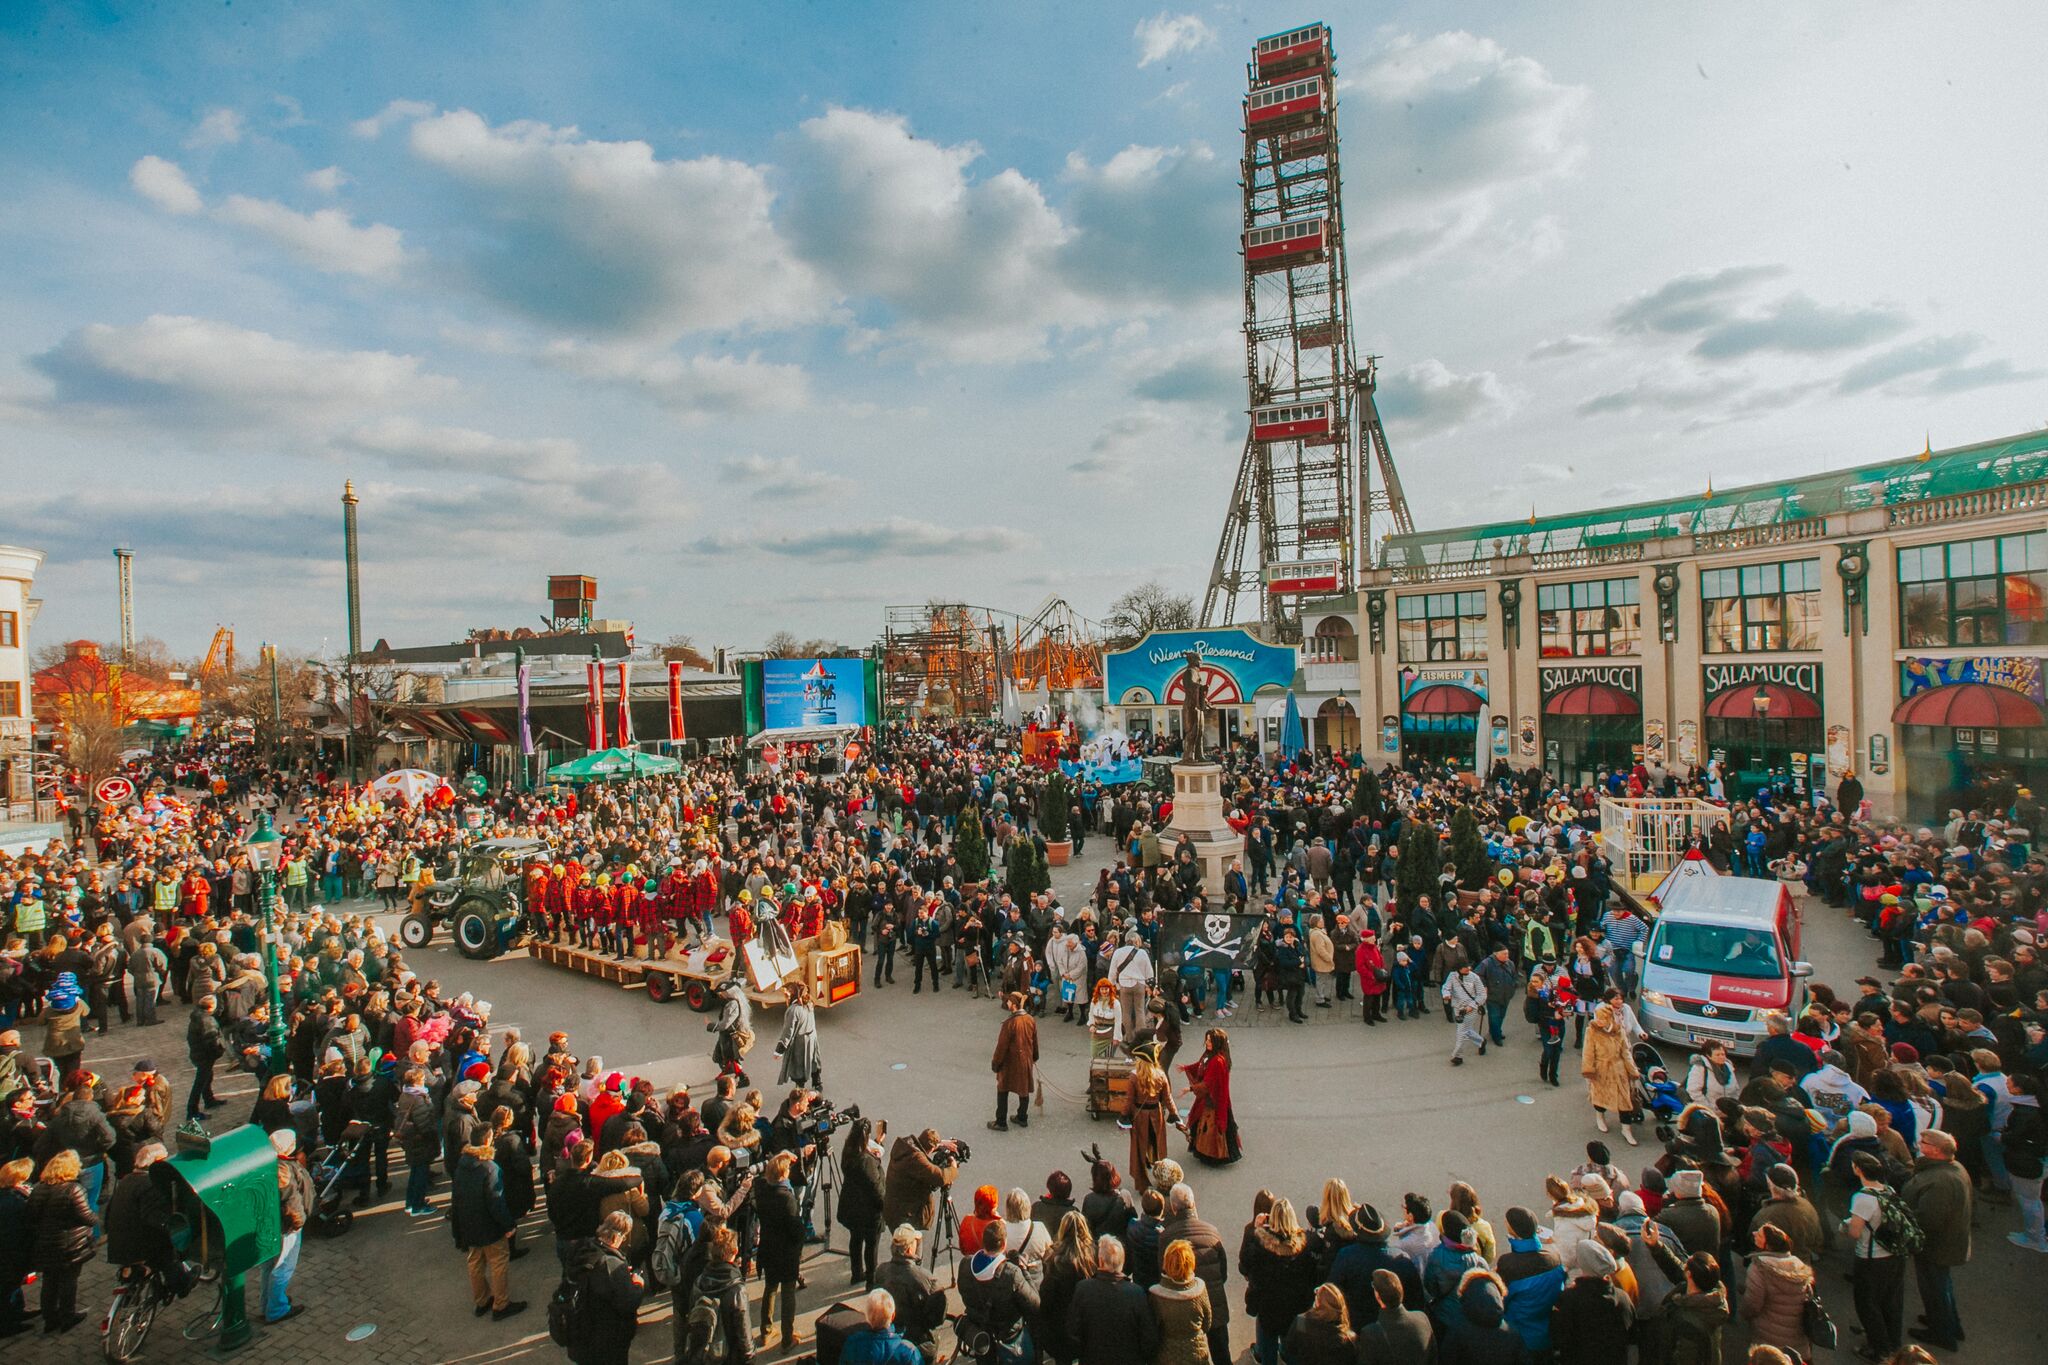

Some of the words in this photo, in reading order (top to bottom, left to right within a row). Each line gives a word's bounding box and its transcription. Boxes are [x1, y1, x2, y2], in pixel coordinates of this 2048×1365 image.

[1194, 640, 1255, 662] Riesenrad
[1421, 671, 1465, 680] EISMEHR
[1543, 667, 1637, 693] SALAMUCCI
[1706, 664, 1817, 694] SALAMUCCI
